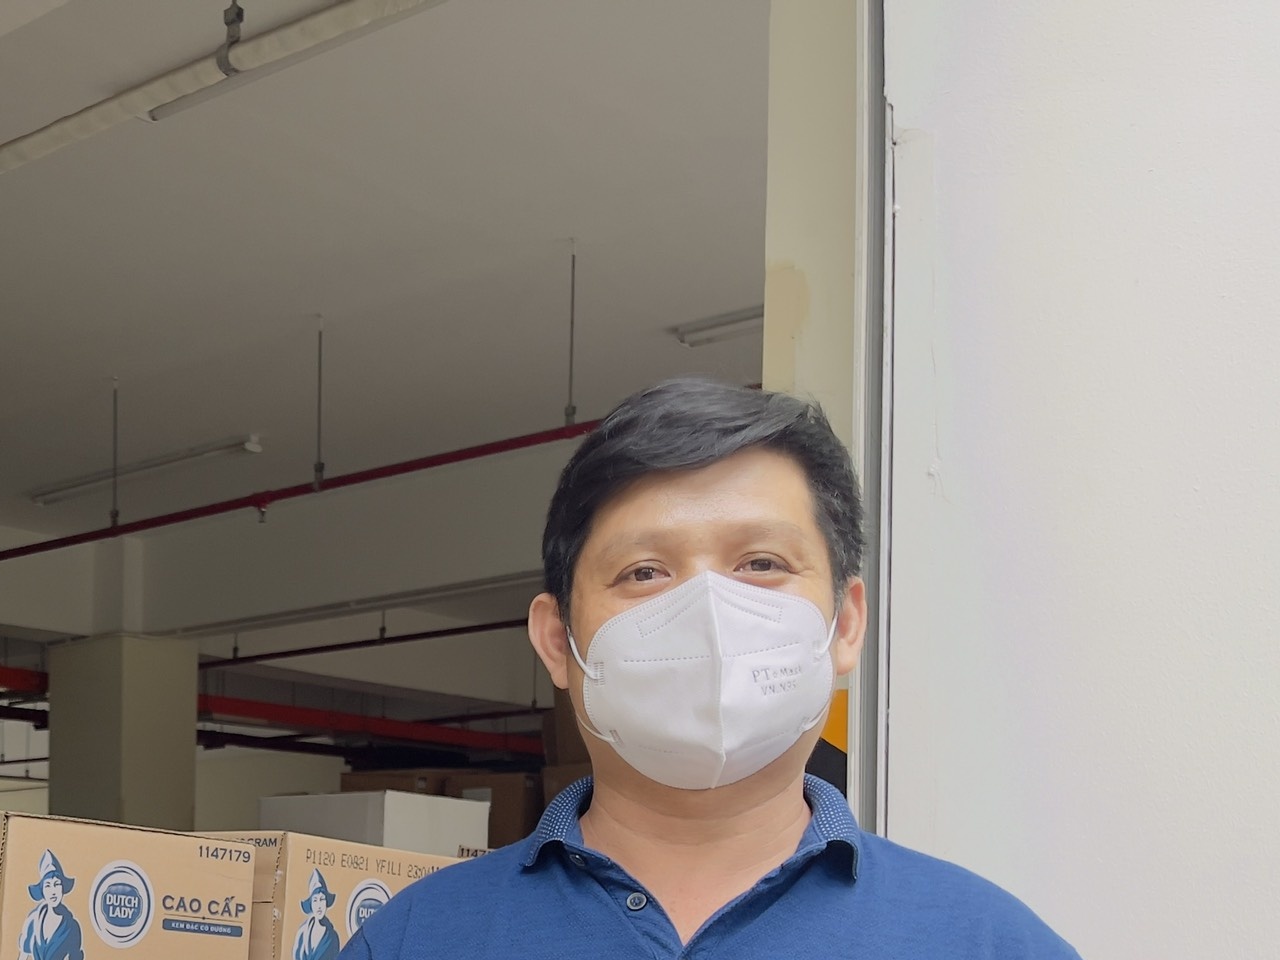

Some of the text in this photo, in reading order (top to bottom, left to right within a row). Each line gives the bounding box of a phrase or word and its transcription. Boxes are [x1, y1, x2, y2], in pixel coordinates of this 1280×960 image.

[198, 845, 251, 863] 1147179
[105, 893, 139, 908] DUTCH
[162, 895, 246, 918] CAO CẤP
[109, 905, 135, 919] LADY
